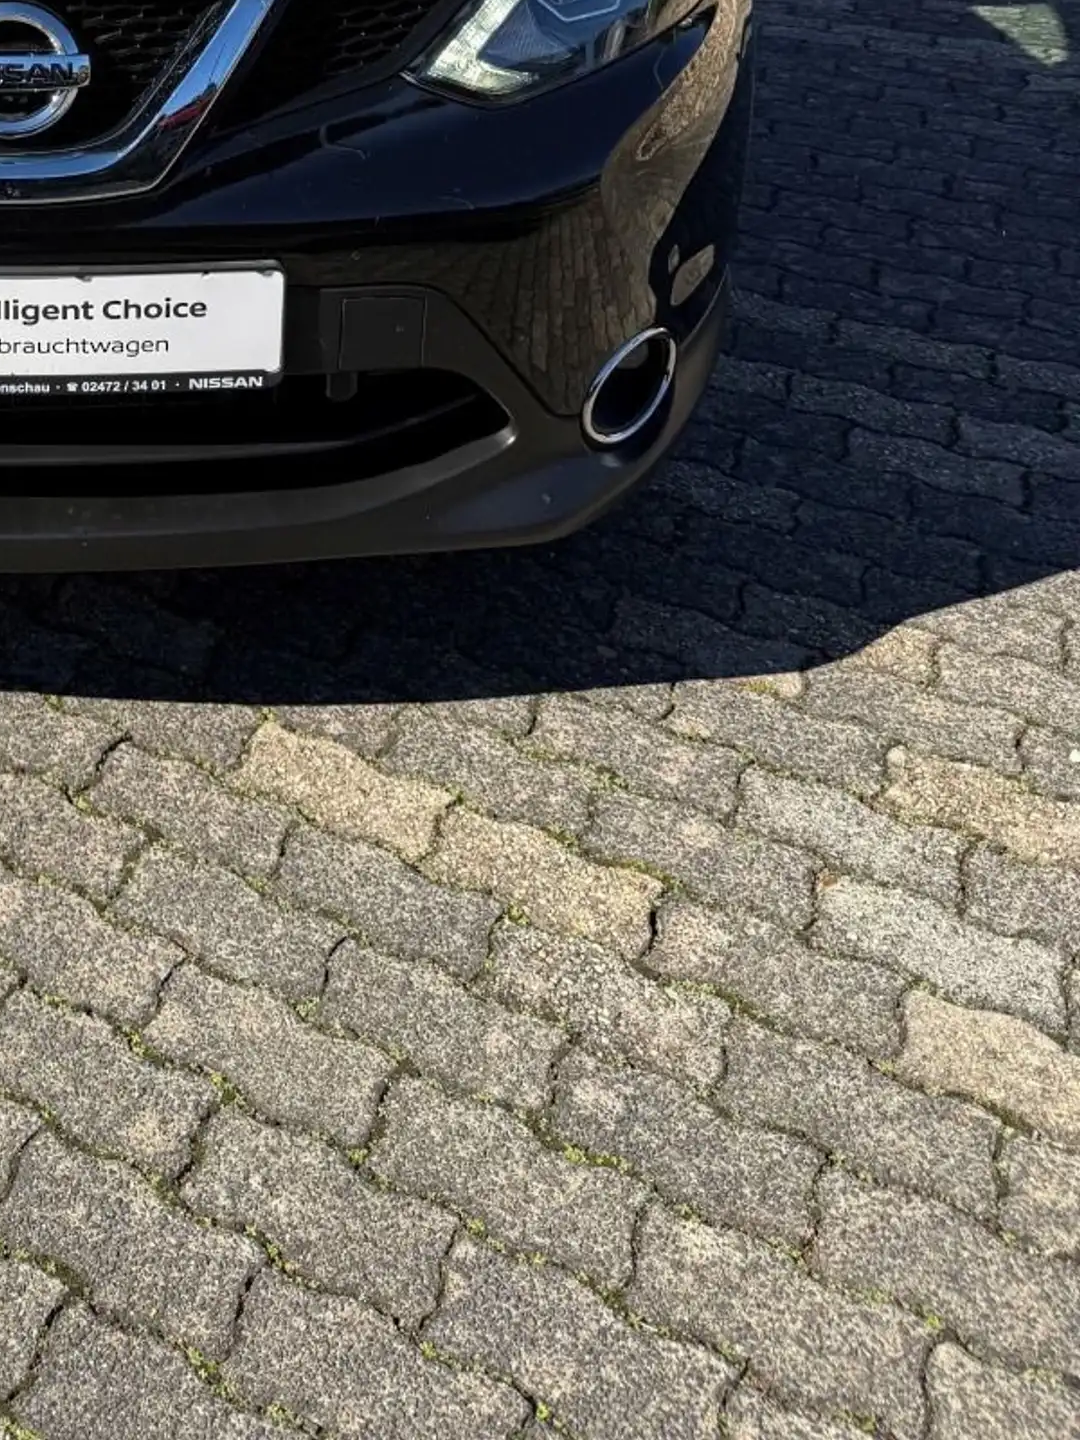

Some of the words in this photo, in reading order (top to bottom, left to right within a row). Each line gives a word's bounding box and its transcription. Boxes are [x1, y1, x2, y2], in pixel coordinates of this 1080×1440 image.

[102, 297, 208, 320] Choice
[81, 380, 121, 393] 02472
[133, 380, 149, 391] 34
[151, 379, 167, 391] 01
[188, 376, 264, 390] NISSAN
